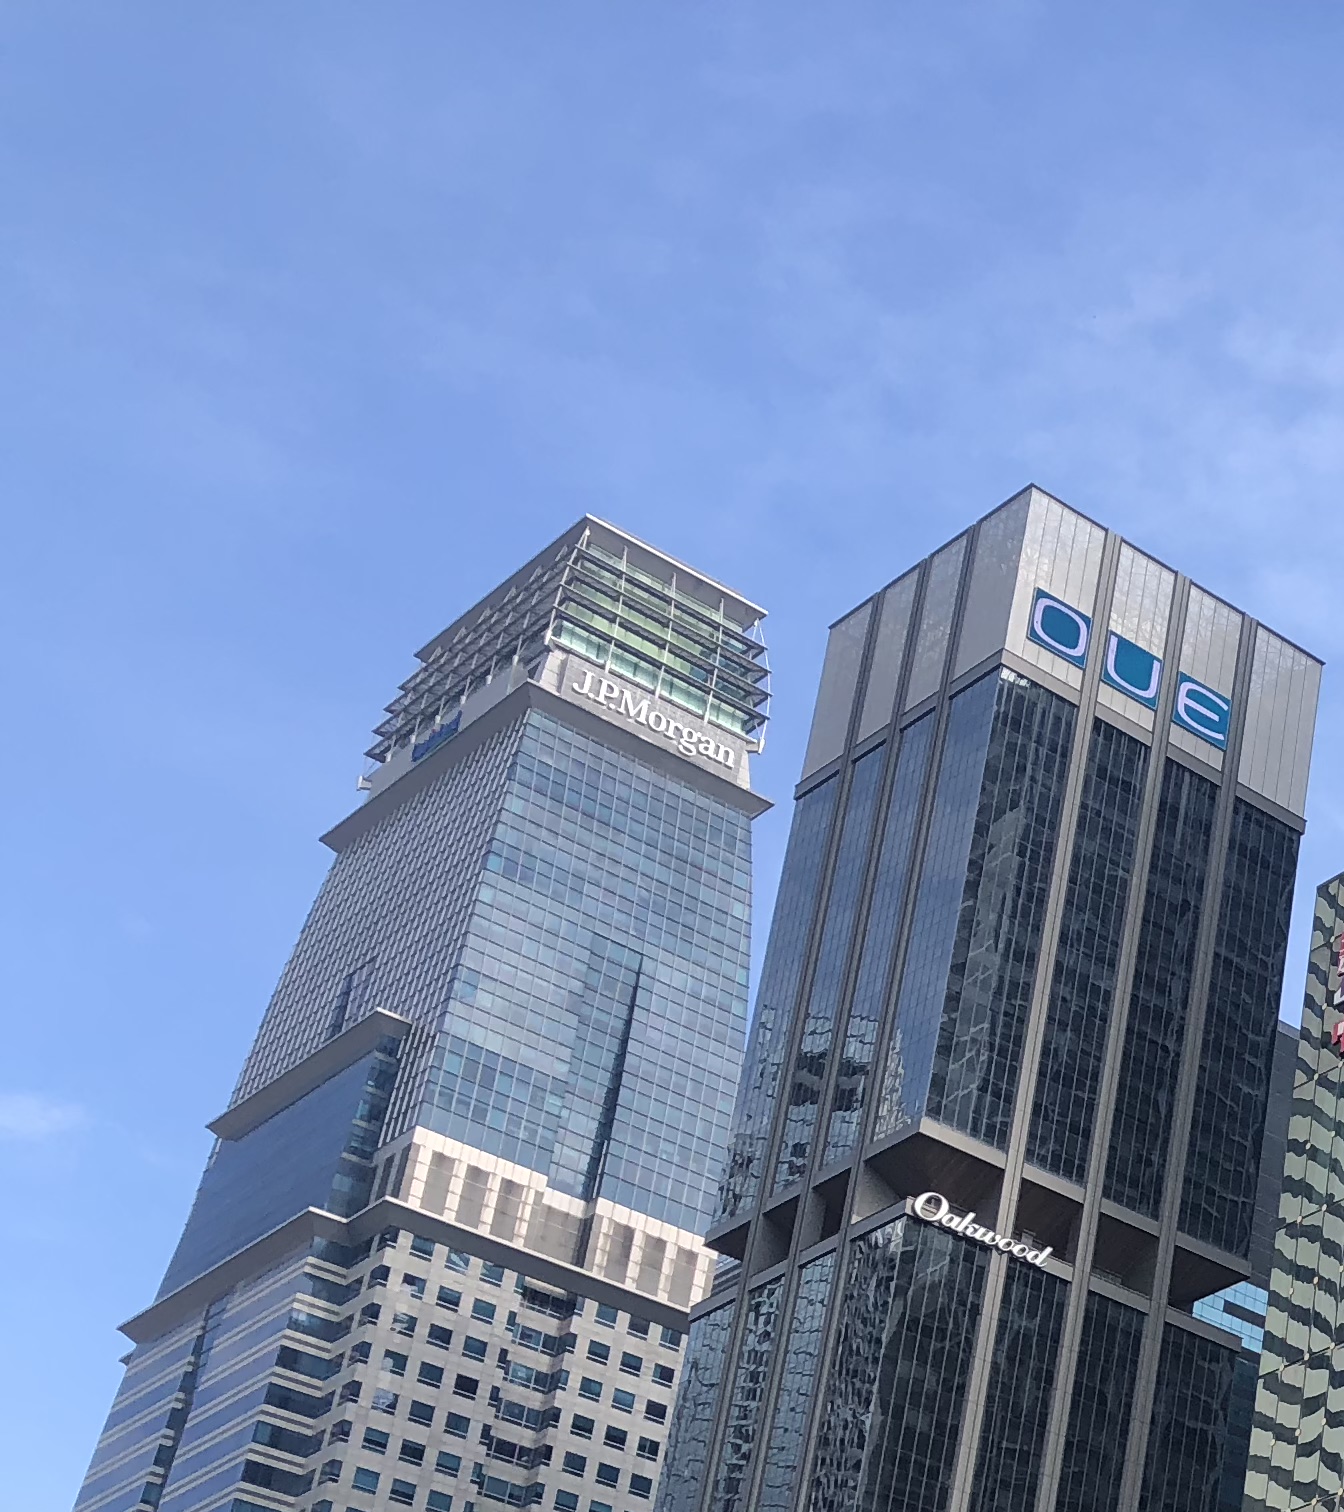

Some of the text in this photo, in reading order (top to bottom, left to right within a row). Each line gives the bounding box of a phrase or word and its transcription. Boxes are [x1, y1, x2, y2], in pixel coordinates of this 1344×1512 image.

[571, 669, 736, 769] J.P.Morgan
[1034, 597, 1229, 741] OUE
[913, 1191, 1054, 1268] Oakwood
